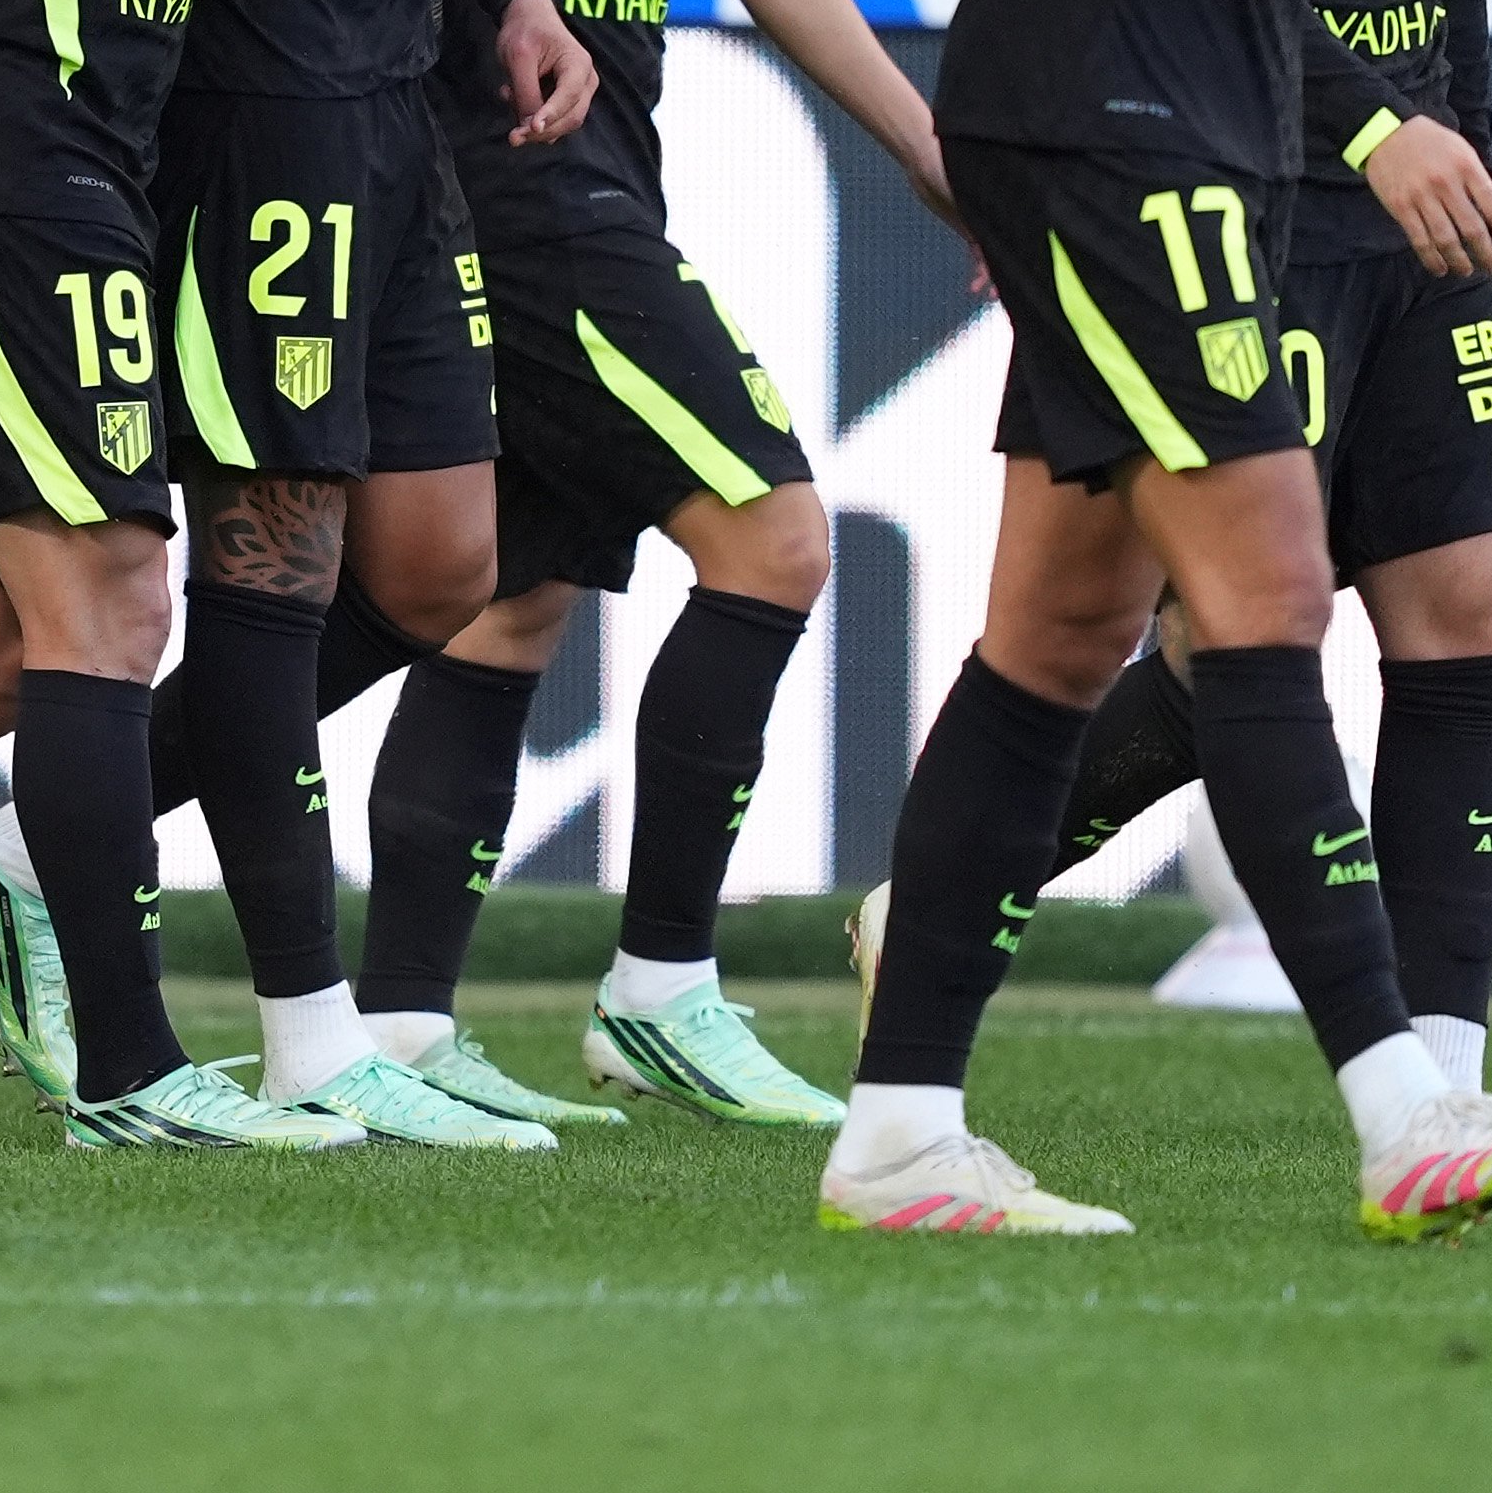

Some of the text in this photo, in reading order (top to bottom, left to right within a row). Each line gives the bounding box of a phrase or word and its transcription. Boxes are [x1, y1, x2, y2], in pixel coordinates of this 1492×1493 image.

[1313, 1, 1426, 56] YADH
[248, 200, 354, 319] 21
[1140, 186, 1256, 312] 17
[55, 270, 154, 388] 19
[1277, 328, 1325, 446] 0
